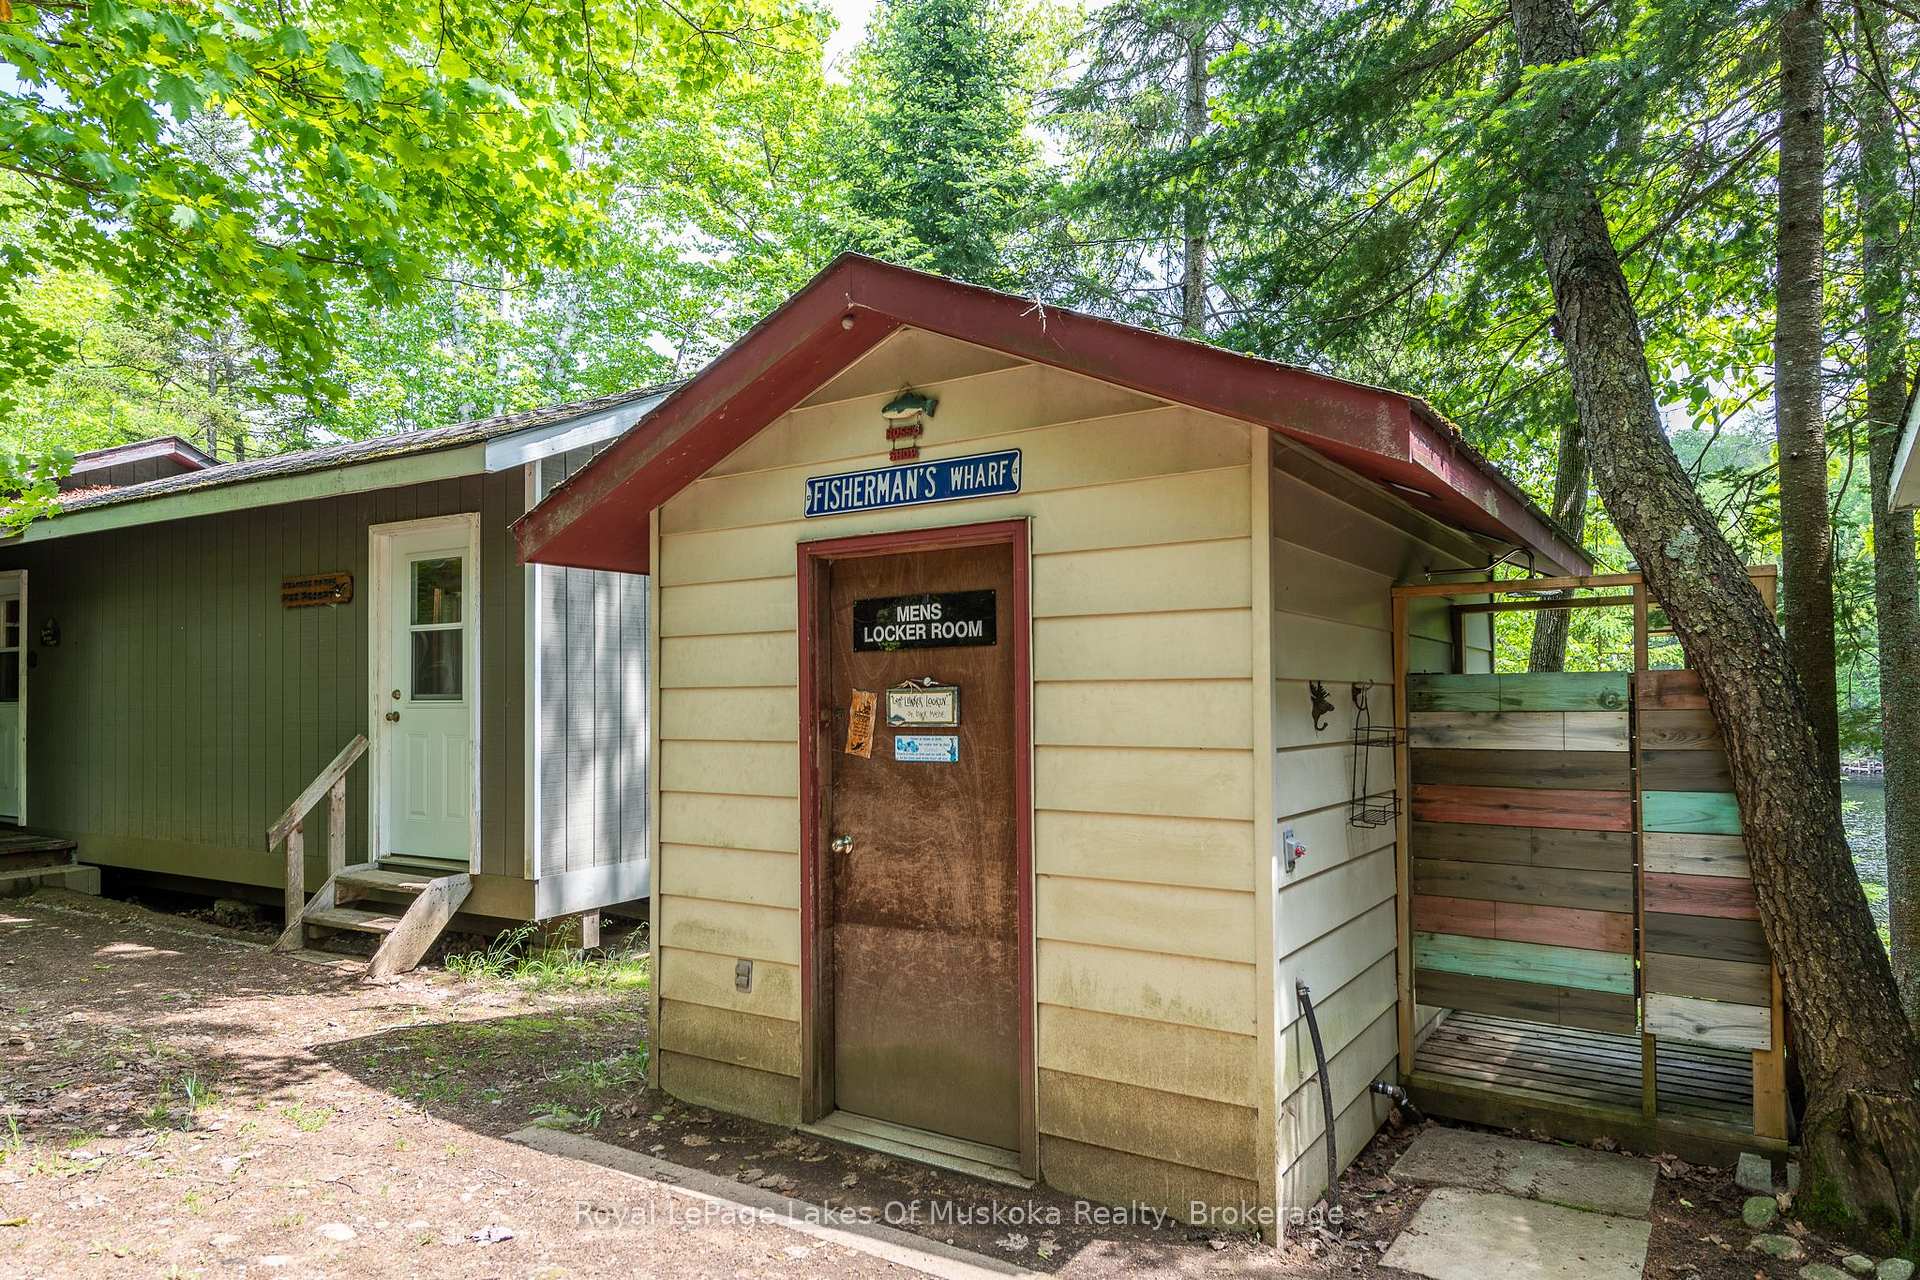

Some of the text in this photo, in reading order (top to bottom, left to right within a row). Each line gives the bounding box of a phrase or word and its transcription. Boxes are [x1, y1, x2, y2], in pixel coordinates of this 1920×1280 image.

[813, 460, 1009, 512] FISHERMAN'S WHARF
[896, 602, 942, 622] MENS
[863, 620, 983, 643] LOCKER ROOM
